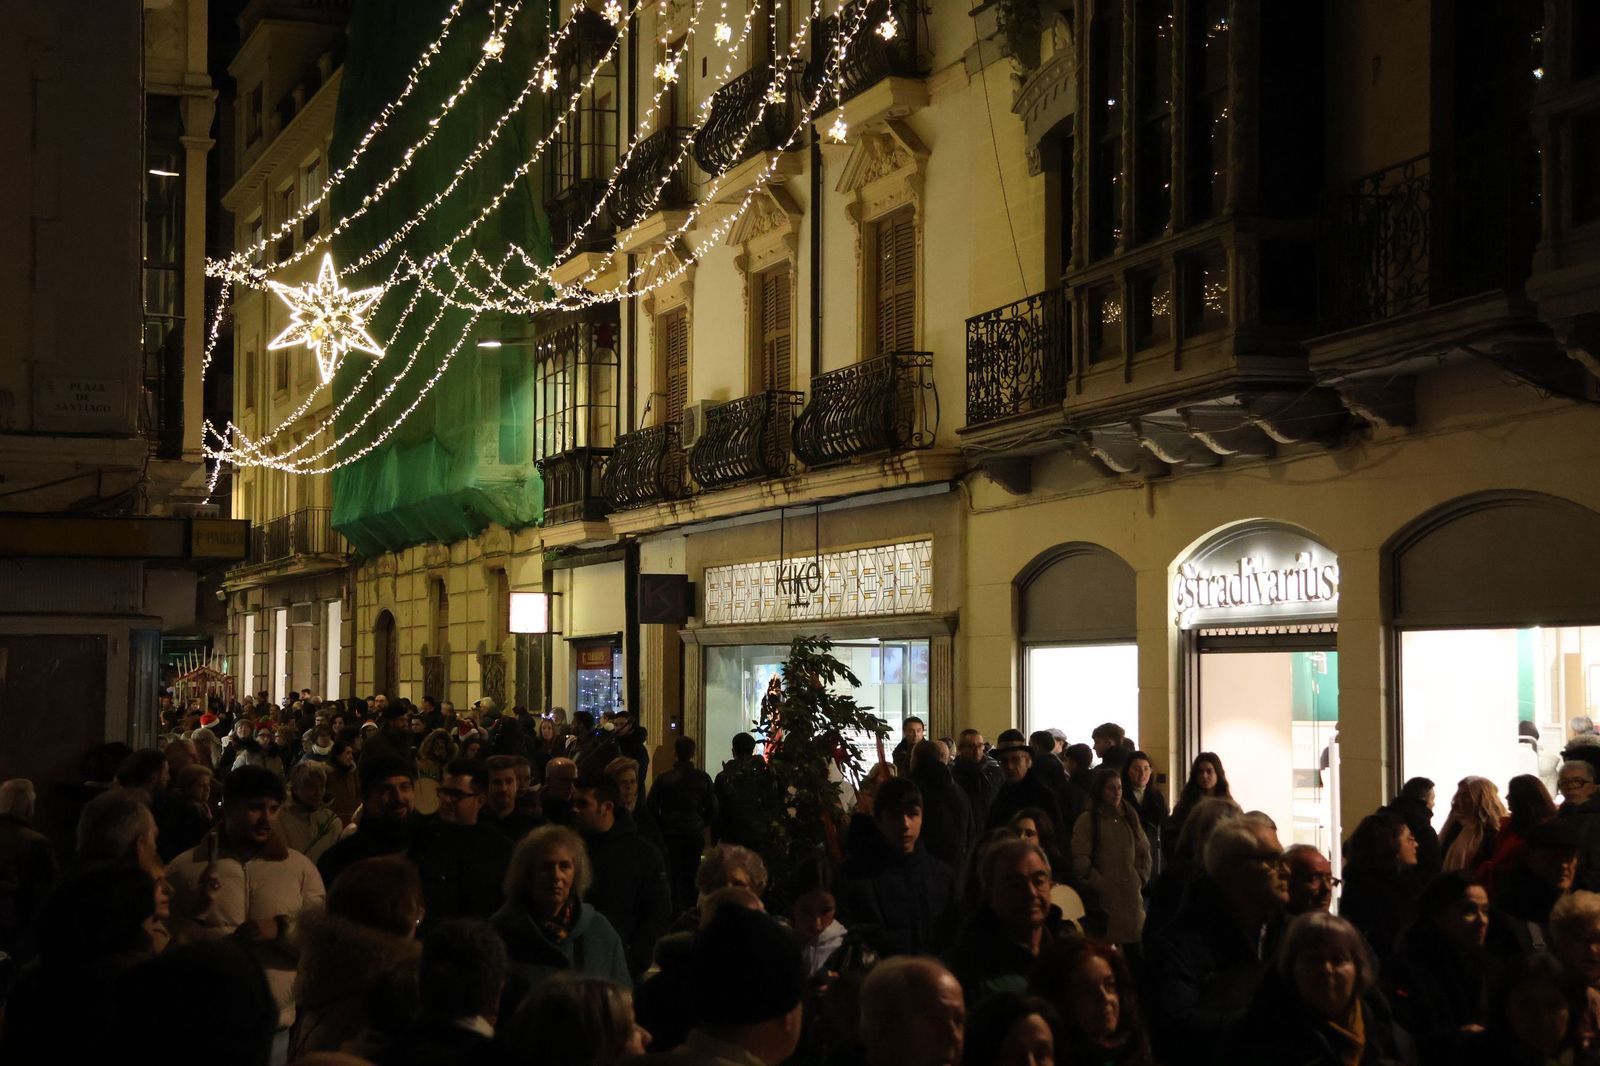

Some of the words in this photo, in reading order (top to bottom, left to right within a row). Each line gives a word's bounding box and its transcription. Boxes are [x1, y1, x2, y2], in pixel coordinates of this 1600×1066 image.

[69, 383, 105, 392] PLAZA
[76, 393, 90, 402] DE
[55, 403, 111, 413] SANTIAGO
[775, 563, 822, 596] KIKO
